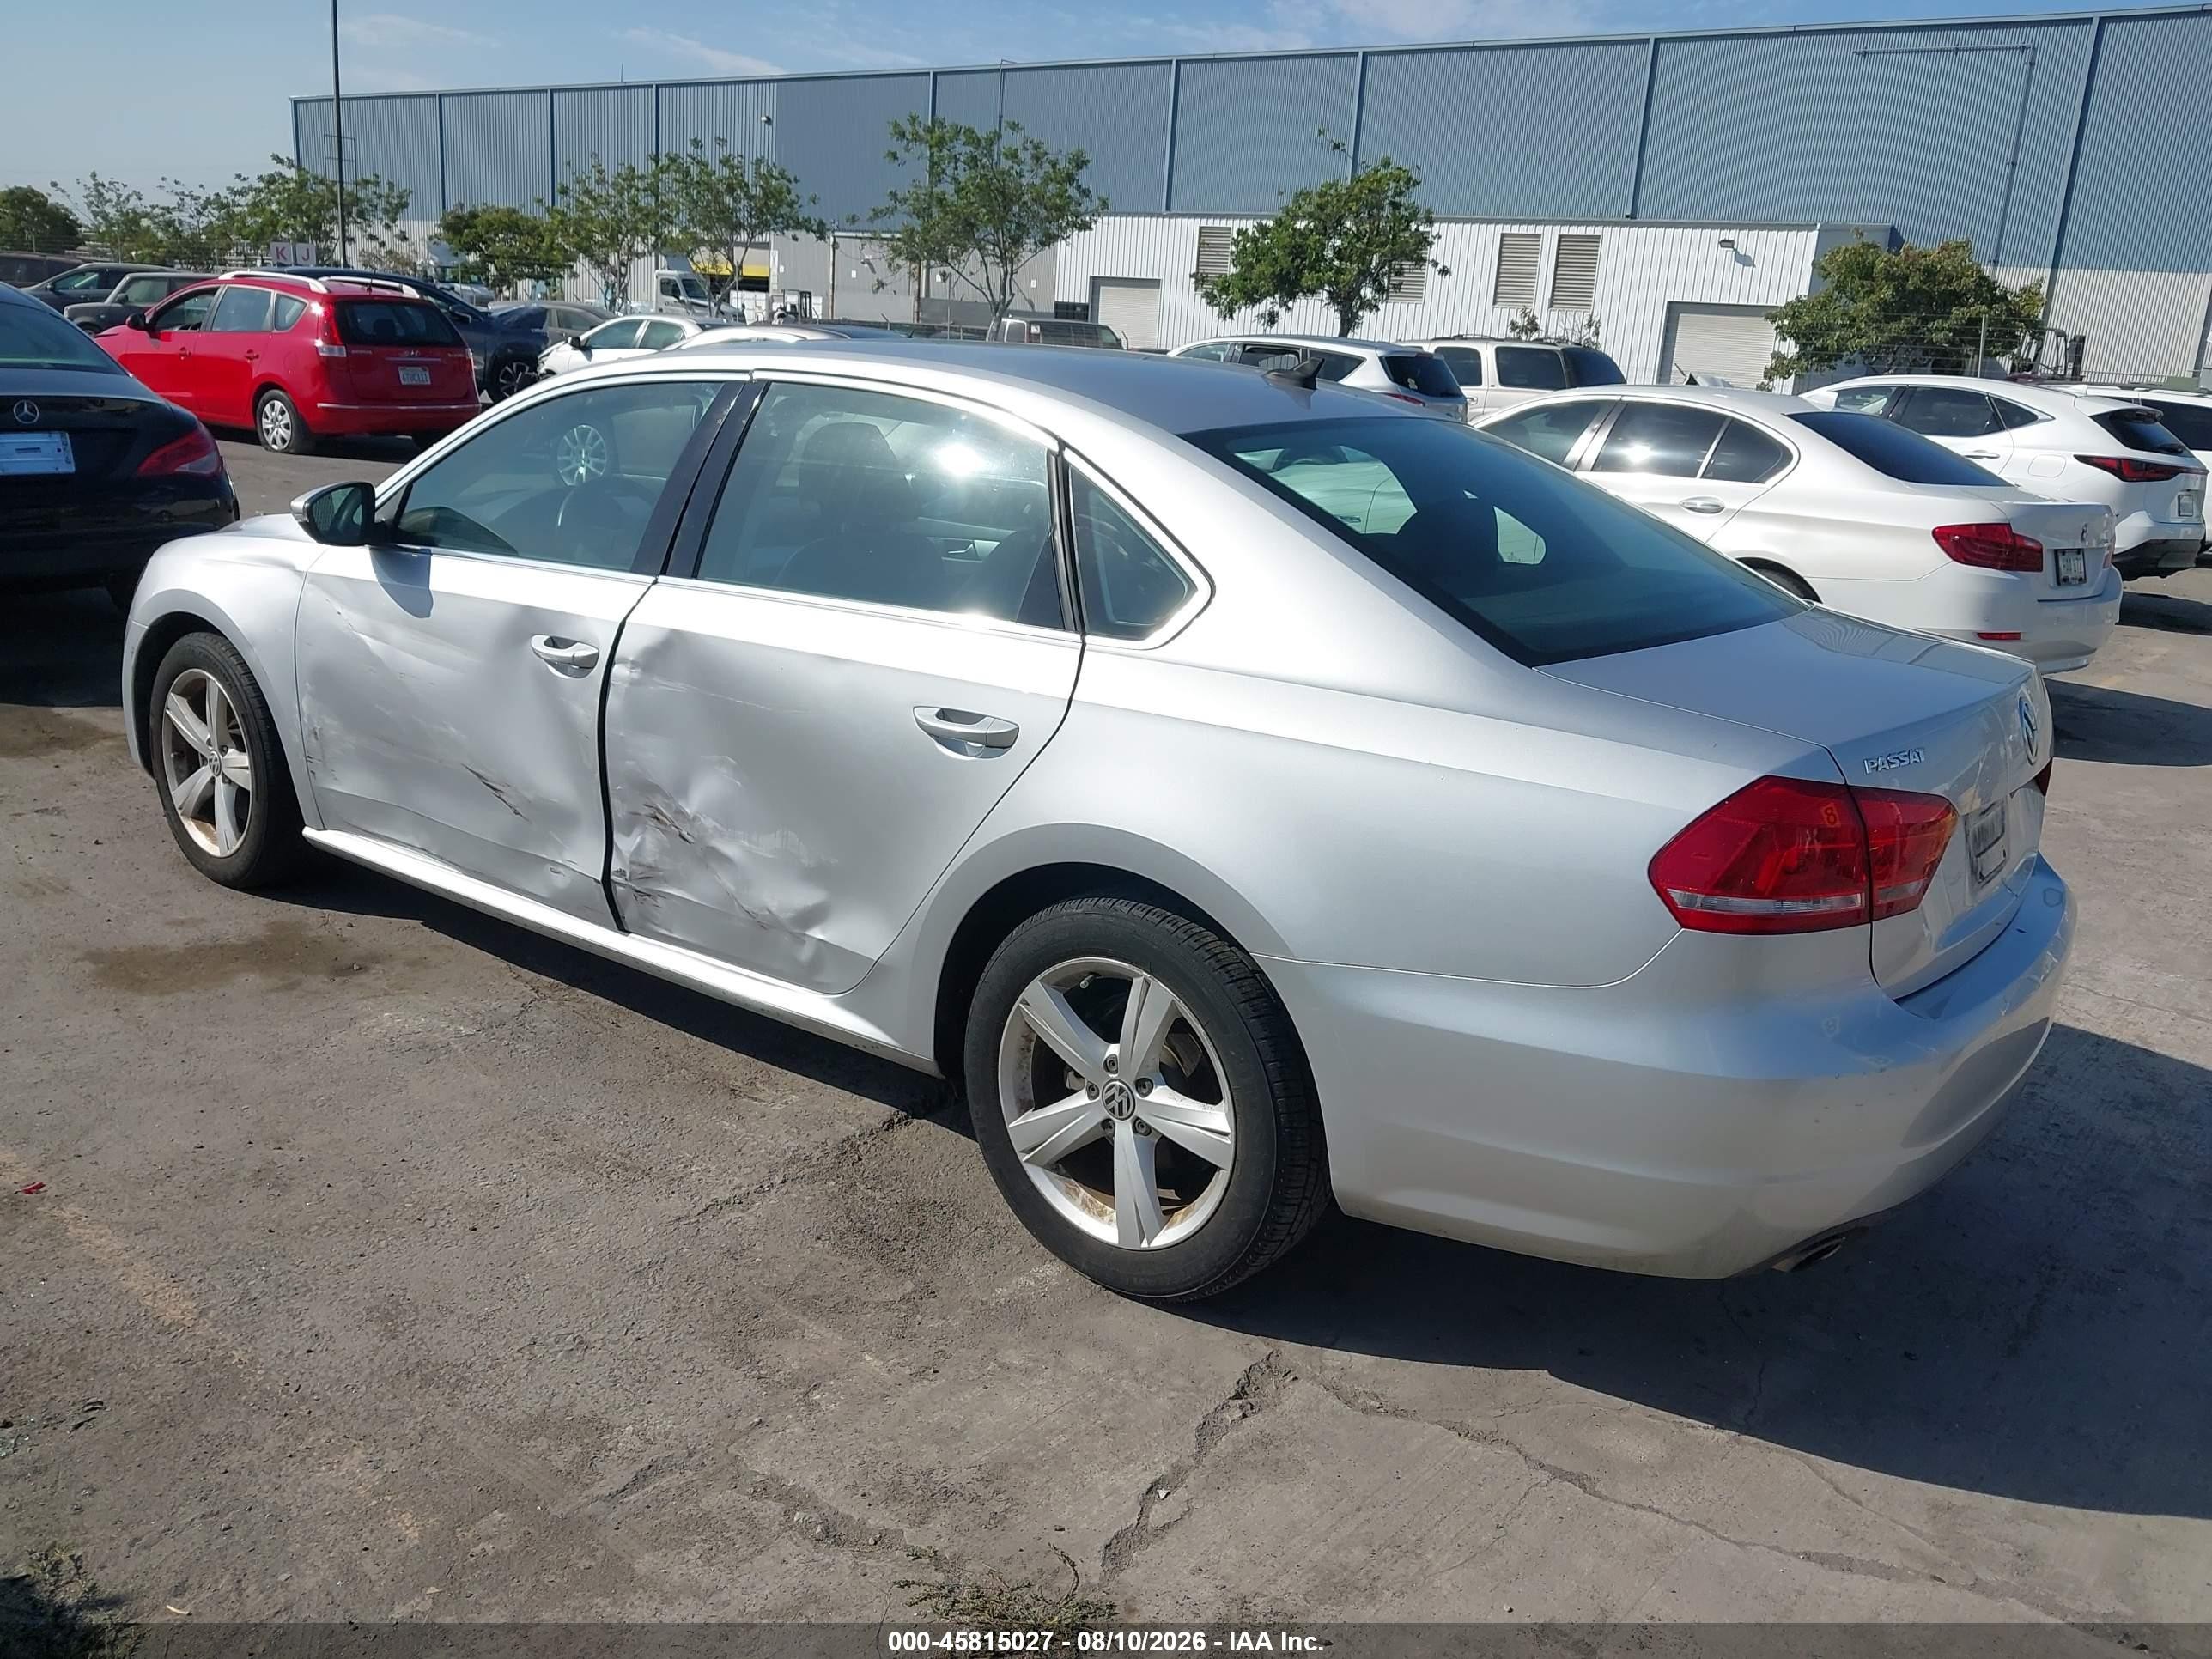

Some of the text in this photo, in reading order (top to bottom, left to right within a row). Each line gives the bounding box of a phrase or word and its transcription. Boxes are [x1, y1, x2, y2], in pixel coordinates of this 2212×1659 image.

[276, 246, 288, 260] K
[301, 247, 310, 261] J
[1863, 747, 1924, 775] PASSAT
